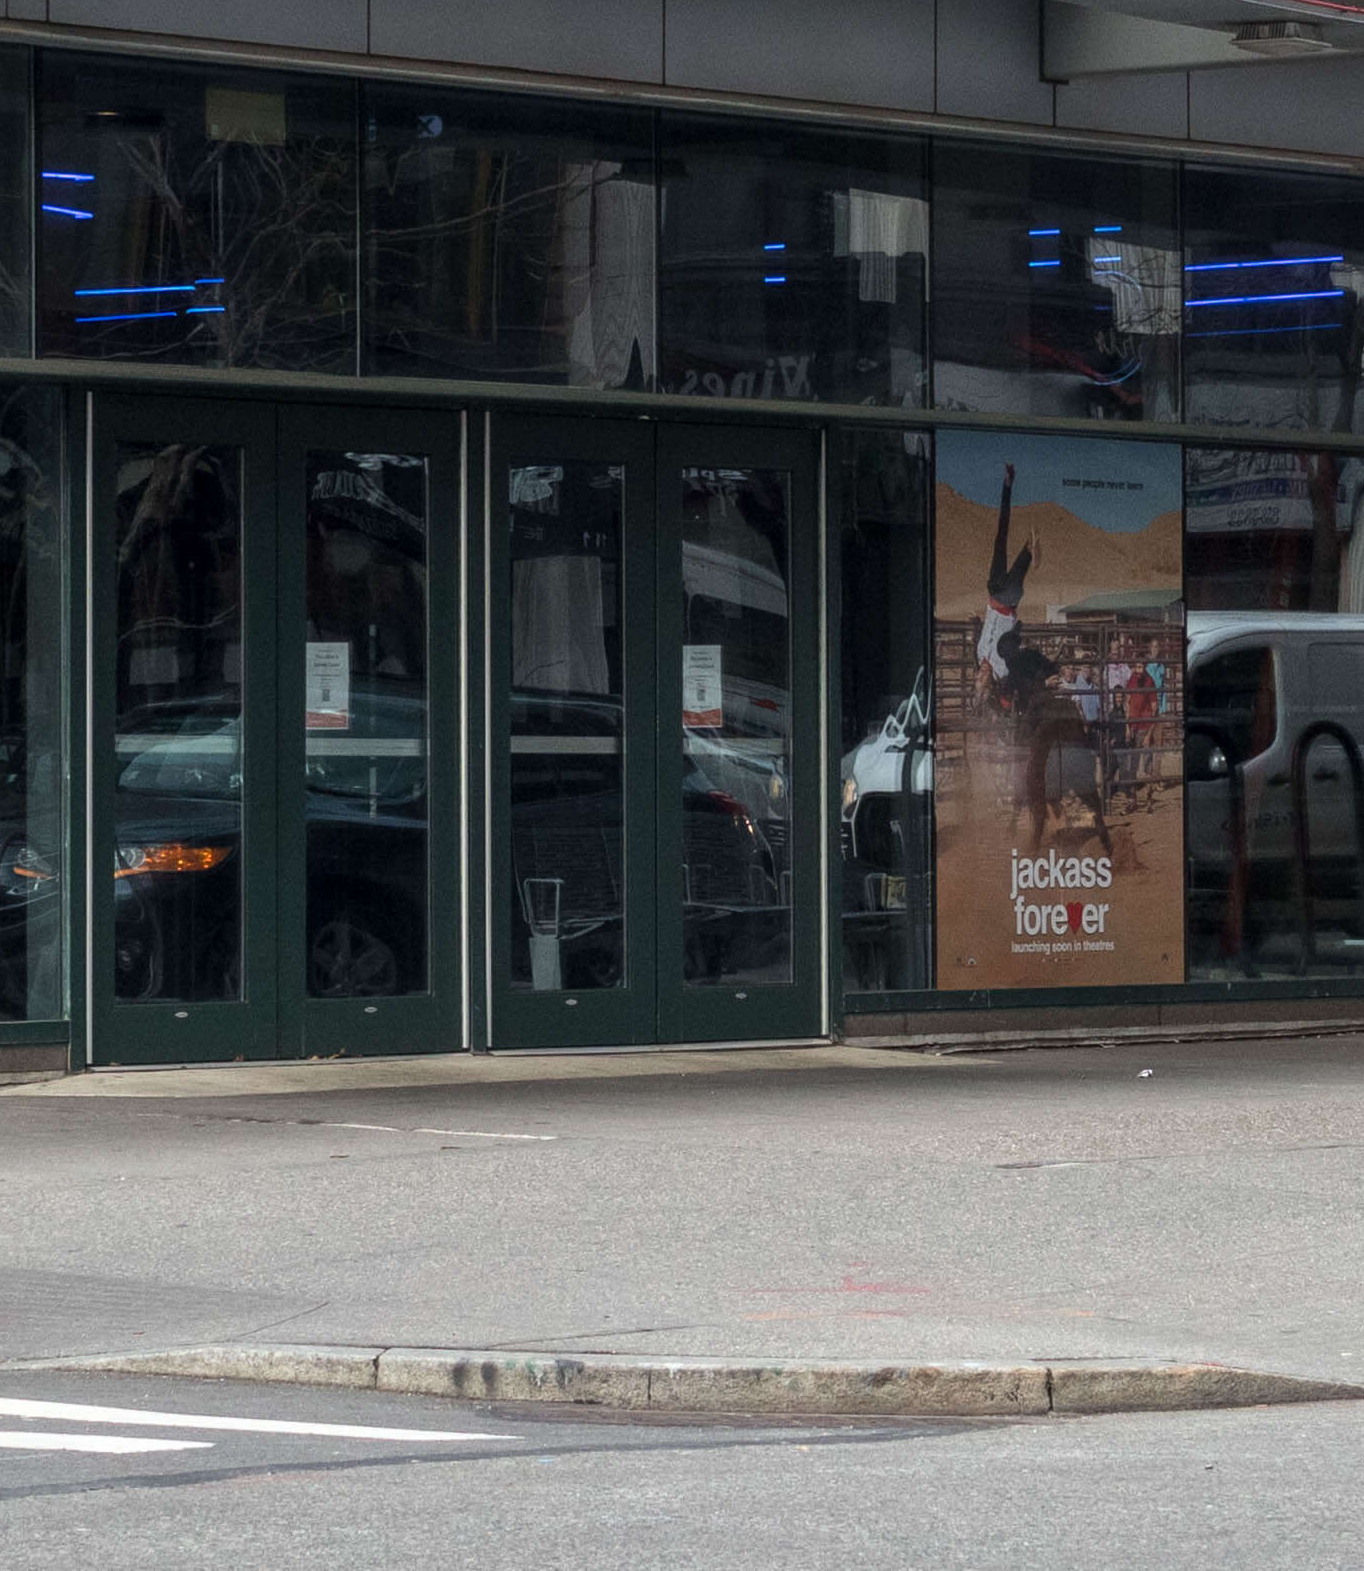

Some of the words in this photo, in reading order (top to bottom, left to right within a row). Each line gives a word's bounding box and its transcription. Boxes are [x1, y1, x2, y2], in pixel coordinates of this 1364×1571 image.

[1010, 848, 1112, 900] jackass
[1052, 942, 1072, 952] soon
[1073, 940, 1082, 950] in
